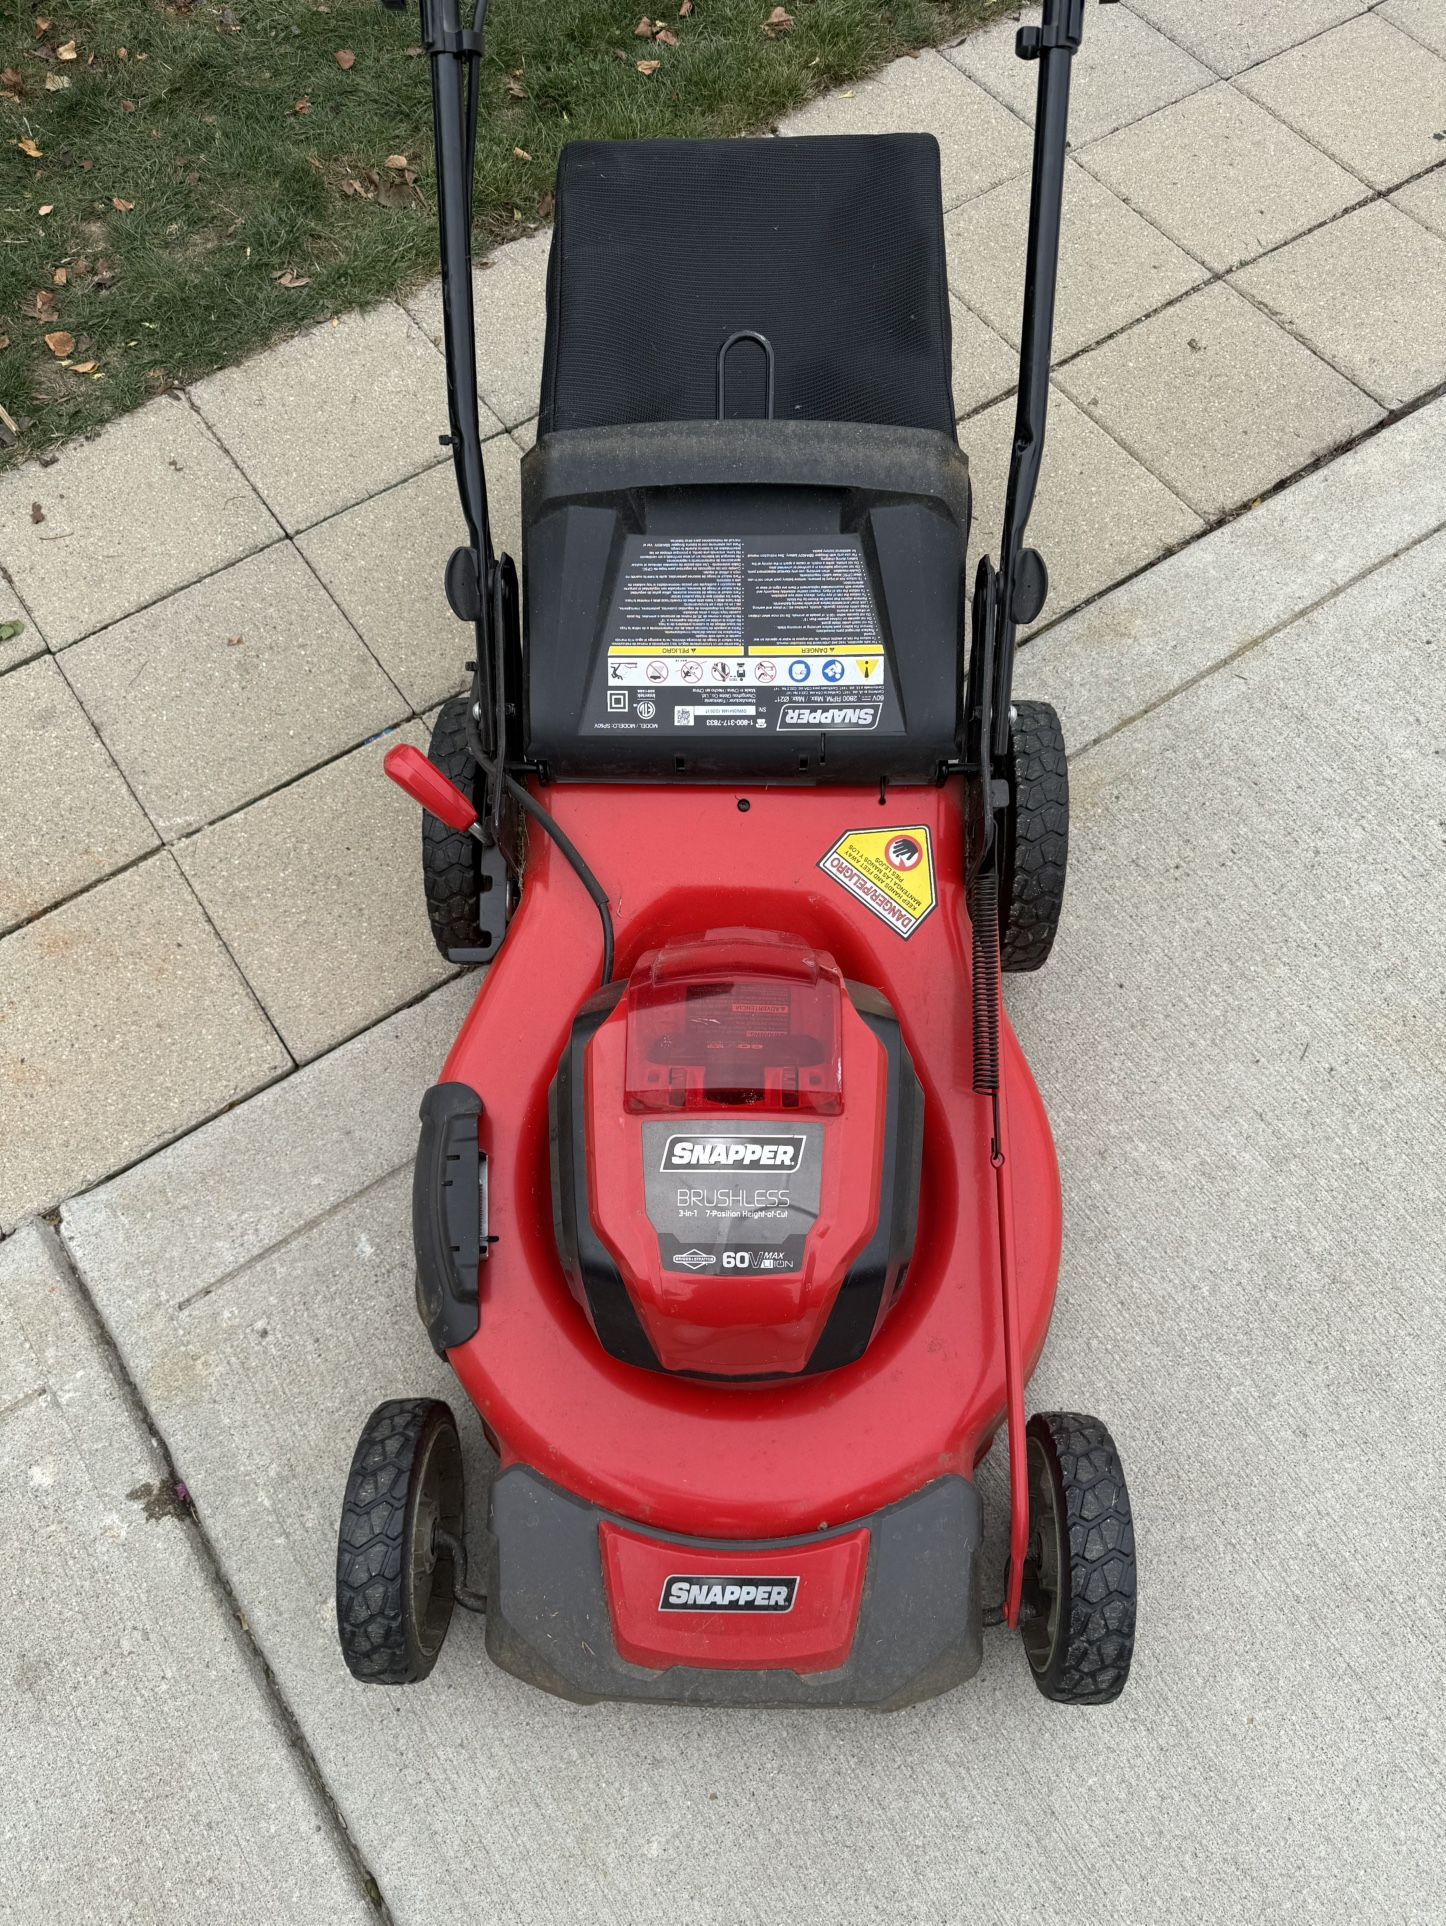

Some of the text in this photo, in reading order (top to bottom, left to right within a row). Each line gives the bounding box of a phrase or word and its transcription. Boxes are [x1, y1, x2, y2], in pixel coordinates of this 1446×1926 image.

[785, 709, 874, 724] SNAPPER
[848, 844, 860, 856] LOS
[844, 850, 860, 866] AWAY
[860, 862, 873, 876] FEET
[874, 857, 904, 883] PIES LEJOS
[870, 873, 885, 886] AND
[882, 871, 893, 883] LAS
[830, 857, 912, 929] DANGER/PELIGRO
[893, 880, 922, 906] MANTENGA
[902, 897, 917, 911] KEEP
[672, 1142, 794, 1165] SNAPPER
[677, 1189, 790, 1206] BRUSHLESS
[678, 1209, 788, 1219] 3-in-1 7-Position Height-of-Cut
[669, 1581, 787, 1606] SNAPPER
